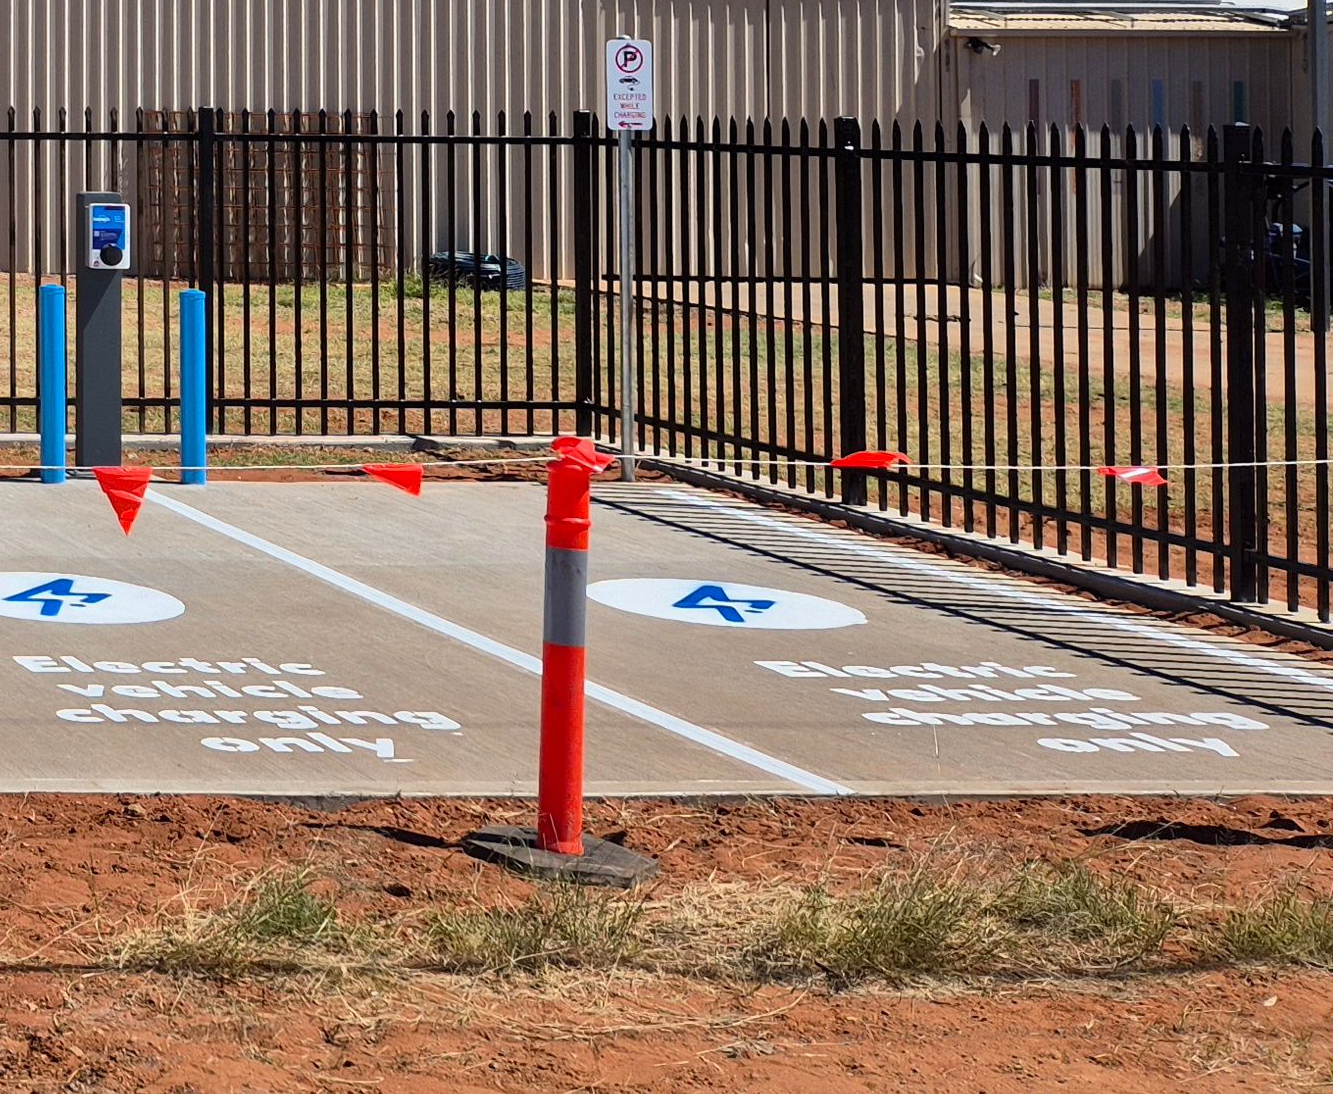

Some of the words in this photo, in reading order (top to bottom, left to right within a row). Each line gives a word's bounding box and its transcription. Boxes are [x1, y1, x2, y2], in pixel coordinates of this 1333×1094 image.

[613, 93, 647, 101] EXCEPTED
[13, 655, 326, 676] Electric
[753, 660, 1077, 678] Electric
[56, 680, 364, 699] vehicle
[829, 683, 1142, 701] vehicle
[56, 704, 461, 730] charging
[861, 707, 1270, 730] charging
[200, 732, 395, 758] only
[1036, 732, 1240, 757] only
